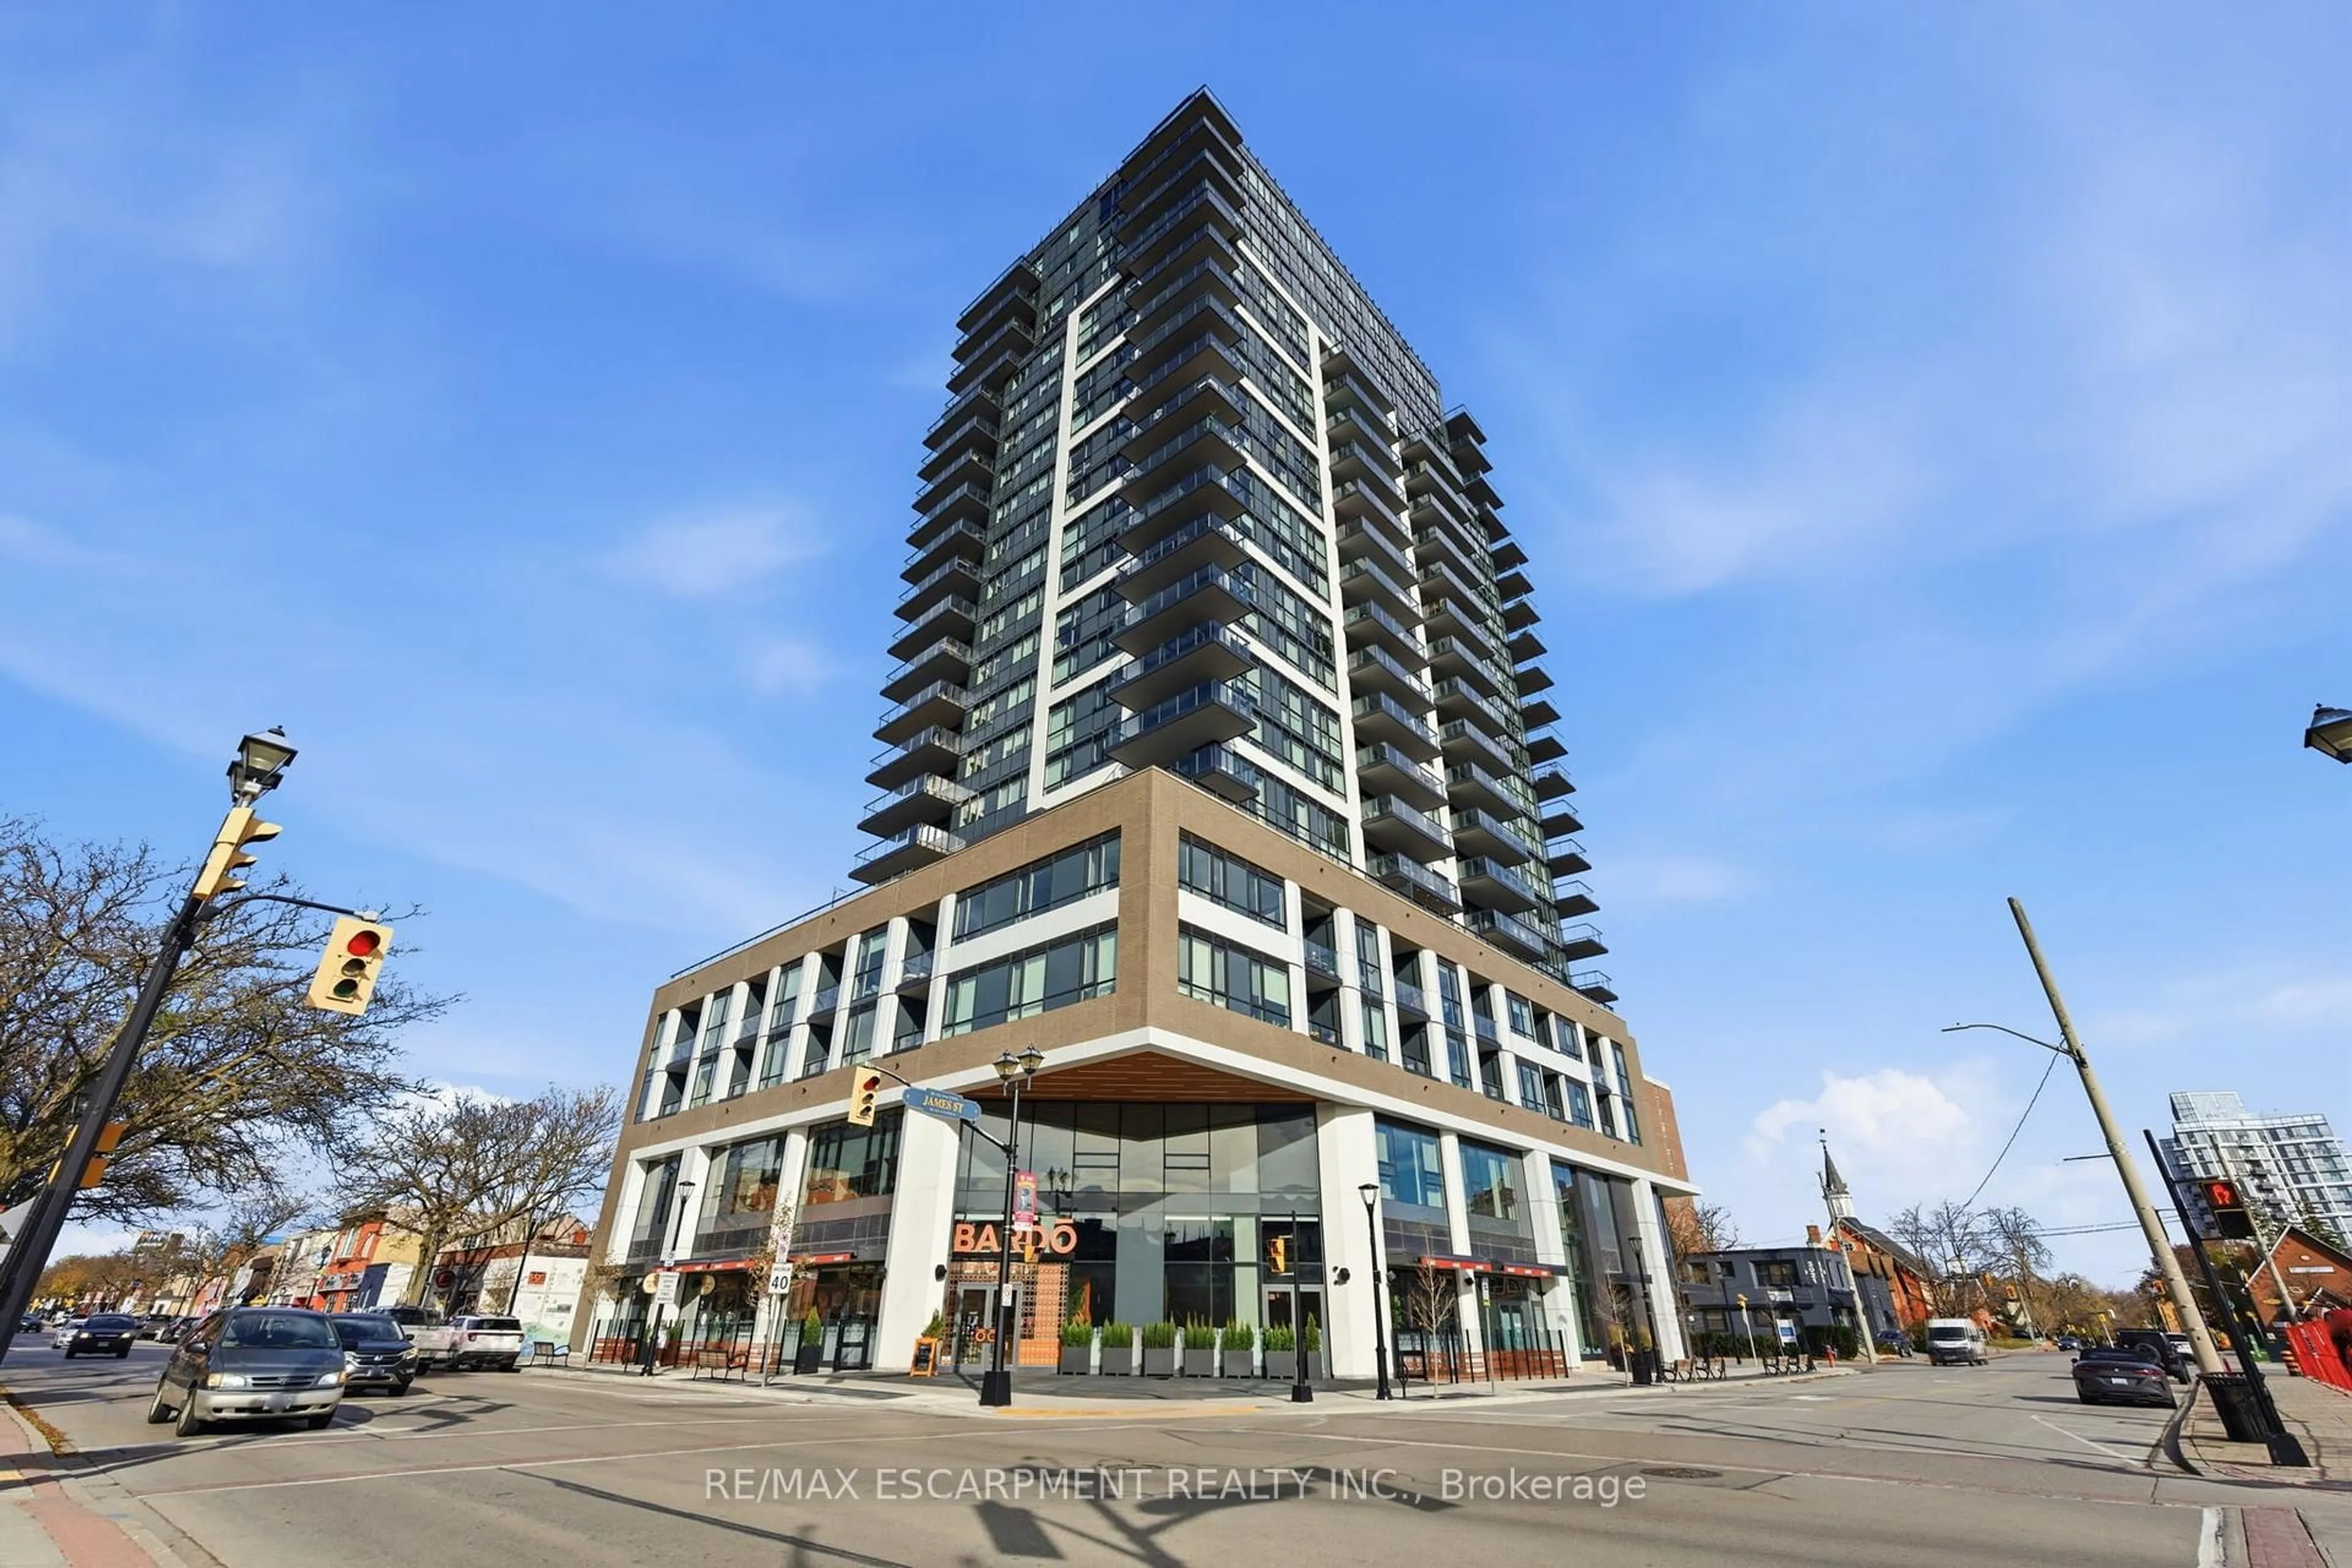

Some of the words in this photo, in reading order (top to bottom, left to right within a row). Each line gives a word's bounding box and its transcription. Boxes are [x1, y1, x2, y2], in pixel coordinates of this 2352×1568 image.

[923, 1095, 952, 1110] JAMES
[952, 1102, 963, 1113] ST
[772, 1276, 788, 1289] 40
